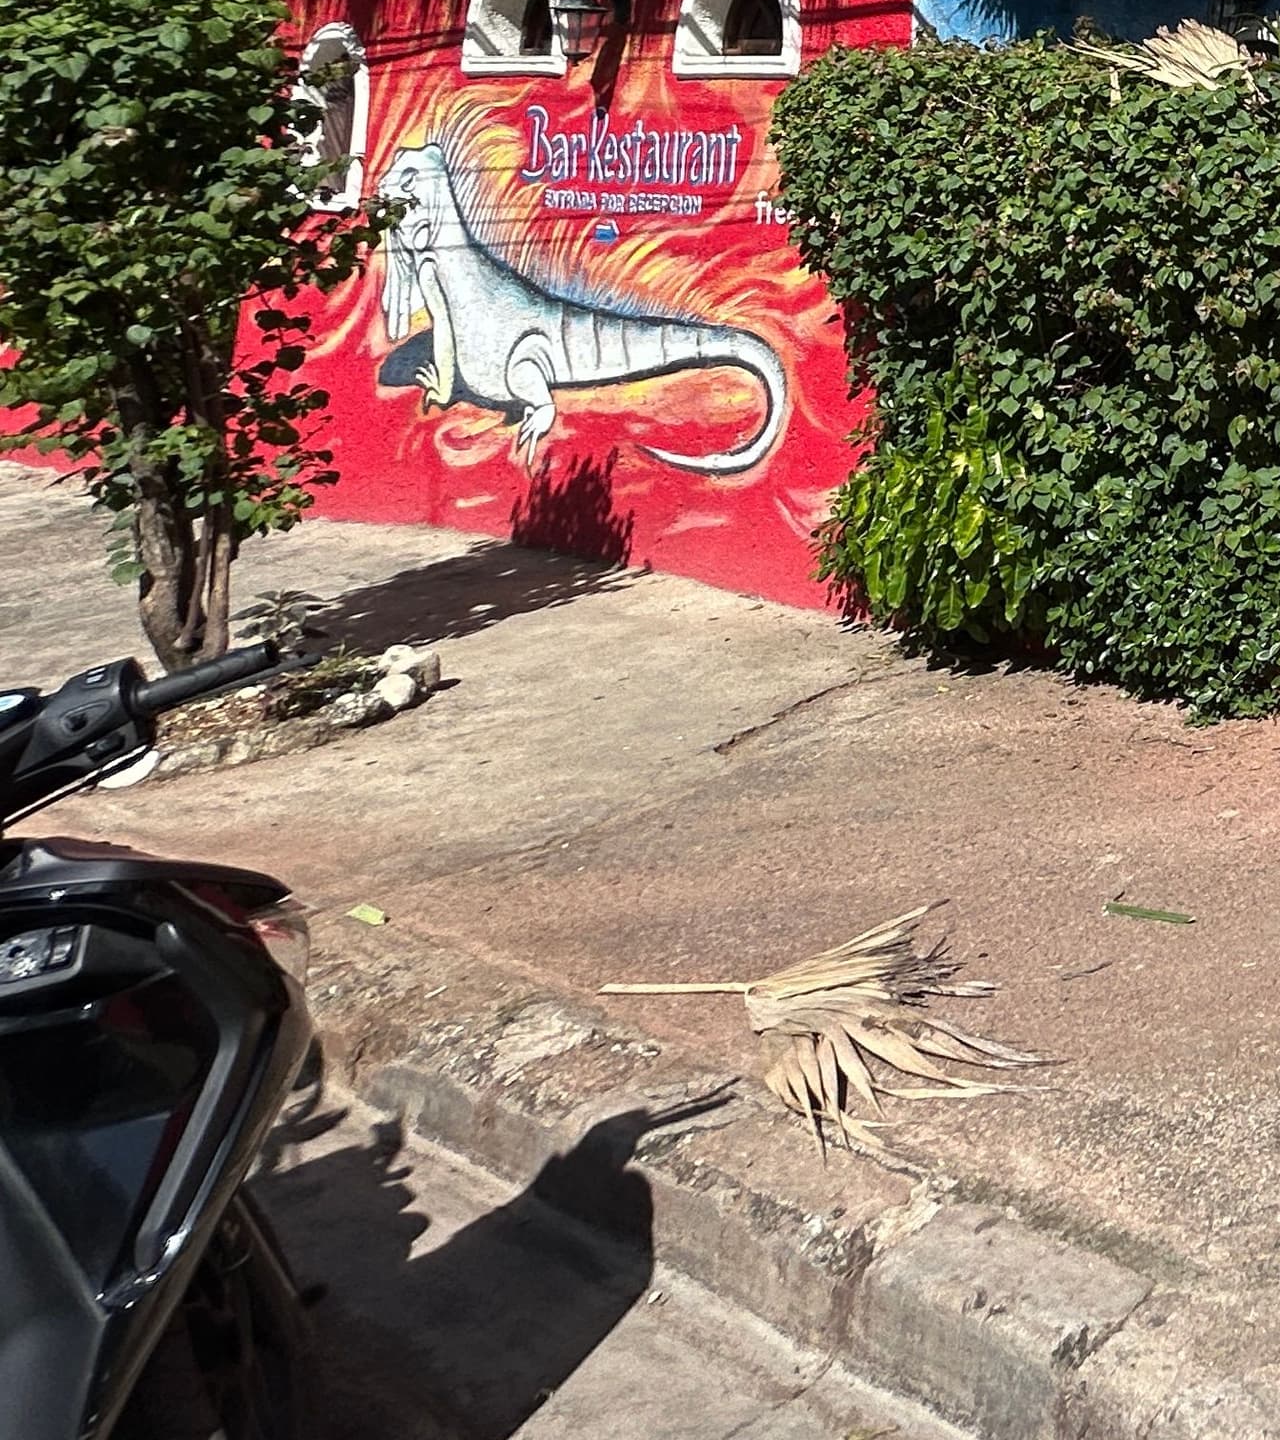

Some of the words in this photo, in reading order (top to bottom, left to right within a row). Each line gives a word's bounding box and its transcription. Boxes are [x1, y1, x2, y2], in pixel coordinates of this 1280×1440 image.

[545, 189, 597, 210] ENTRADA
[600, 191, 625, 212] POR
[629, 192, 702, 215] RECEPCION
